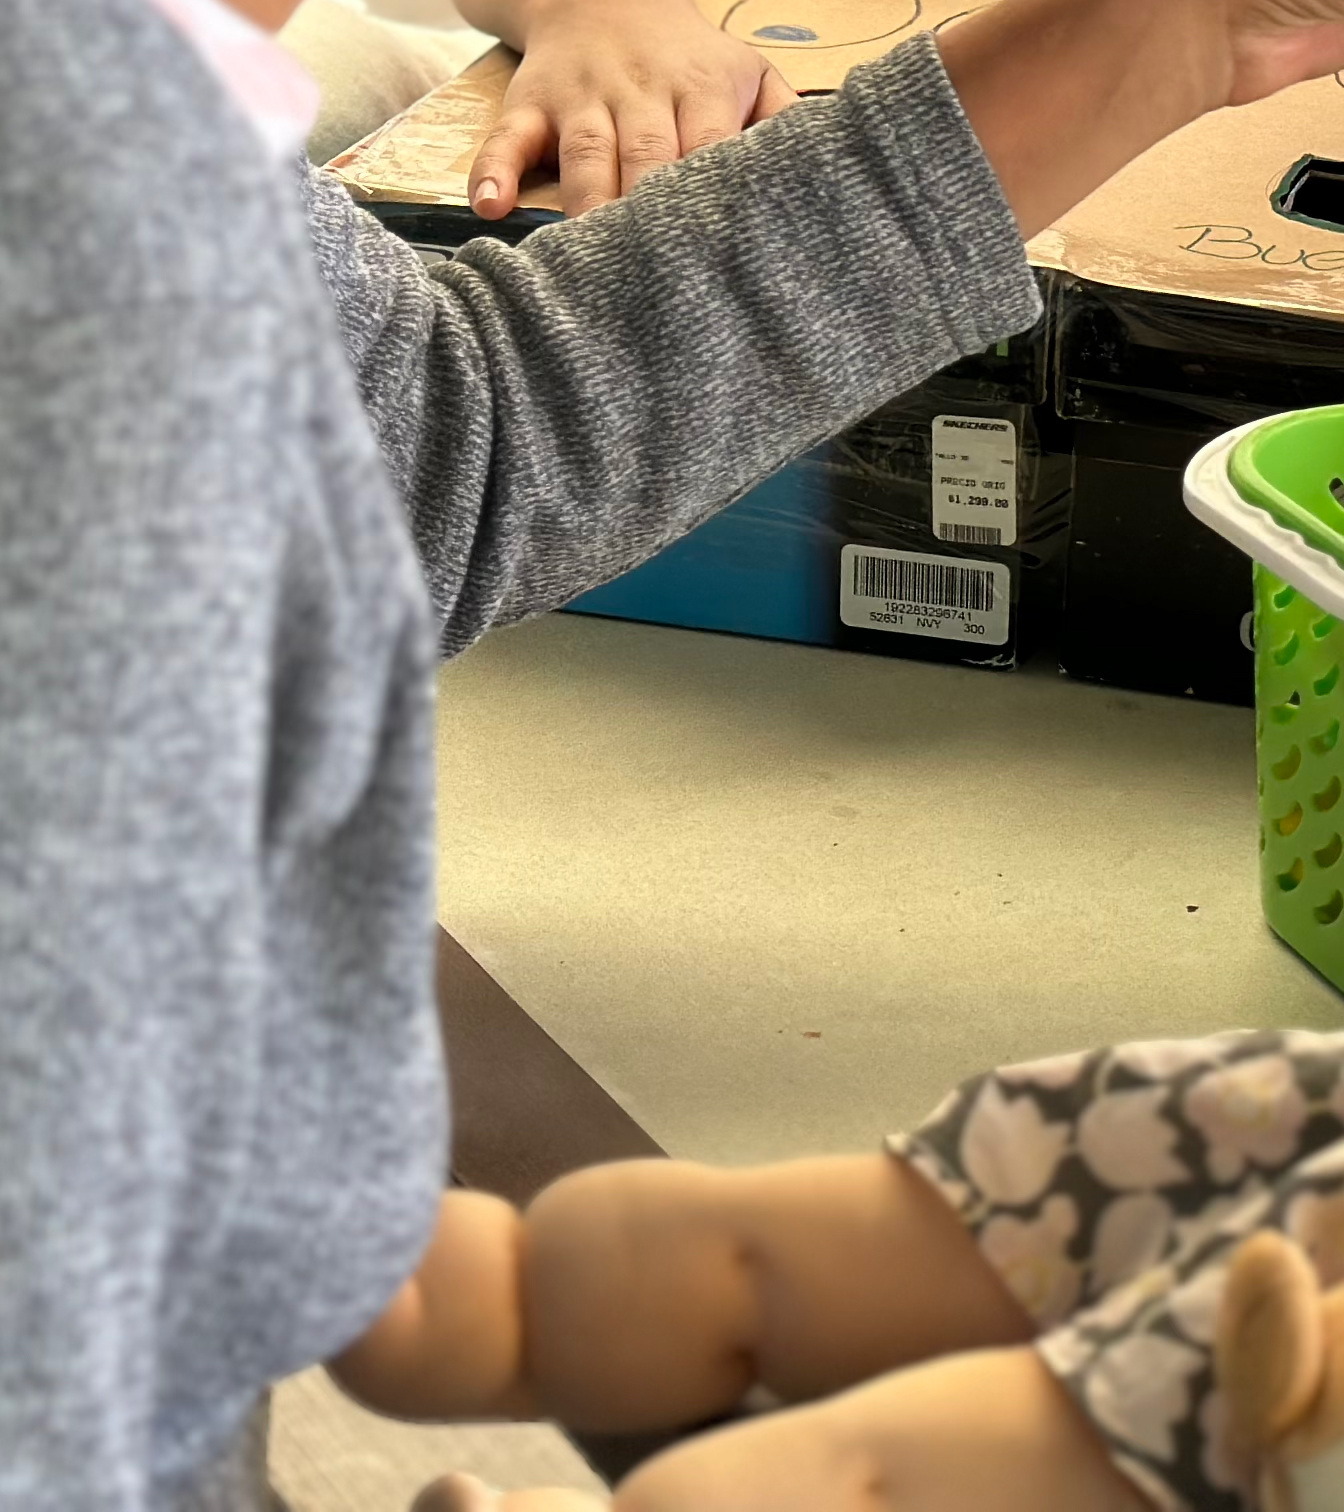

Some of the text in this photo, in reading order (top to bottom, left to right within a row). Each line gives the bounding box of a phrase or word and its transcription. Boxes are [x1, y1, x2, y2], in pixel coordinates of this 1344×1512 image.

[942, 420, 1008, 432] SKECHERS
[940, 476, 976, 487] PRECIO
[884, 601, 972, 621] 192283296741
[916, 617, 942, 629] NVY
[963, 623, 985, 634] 300
